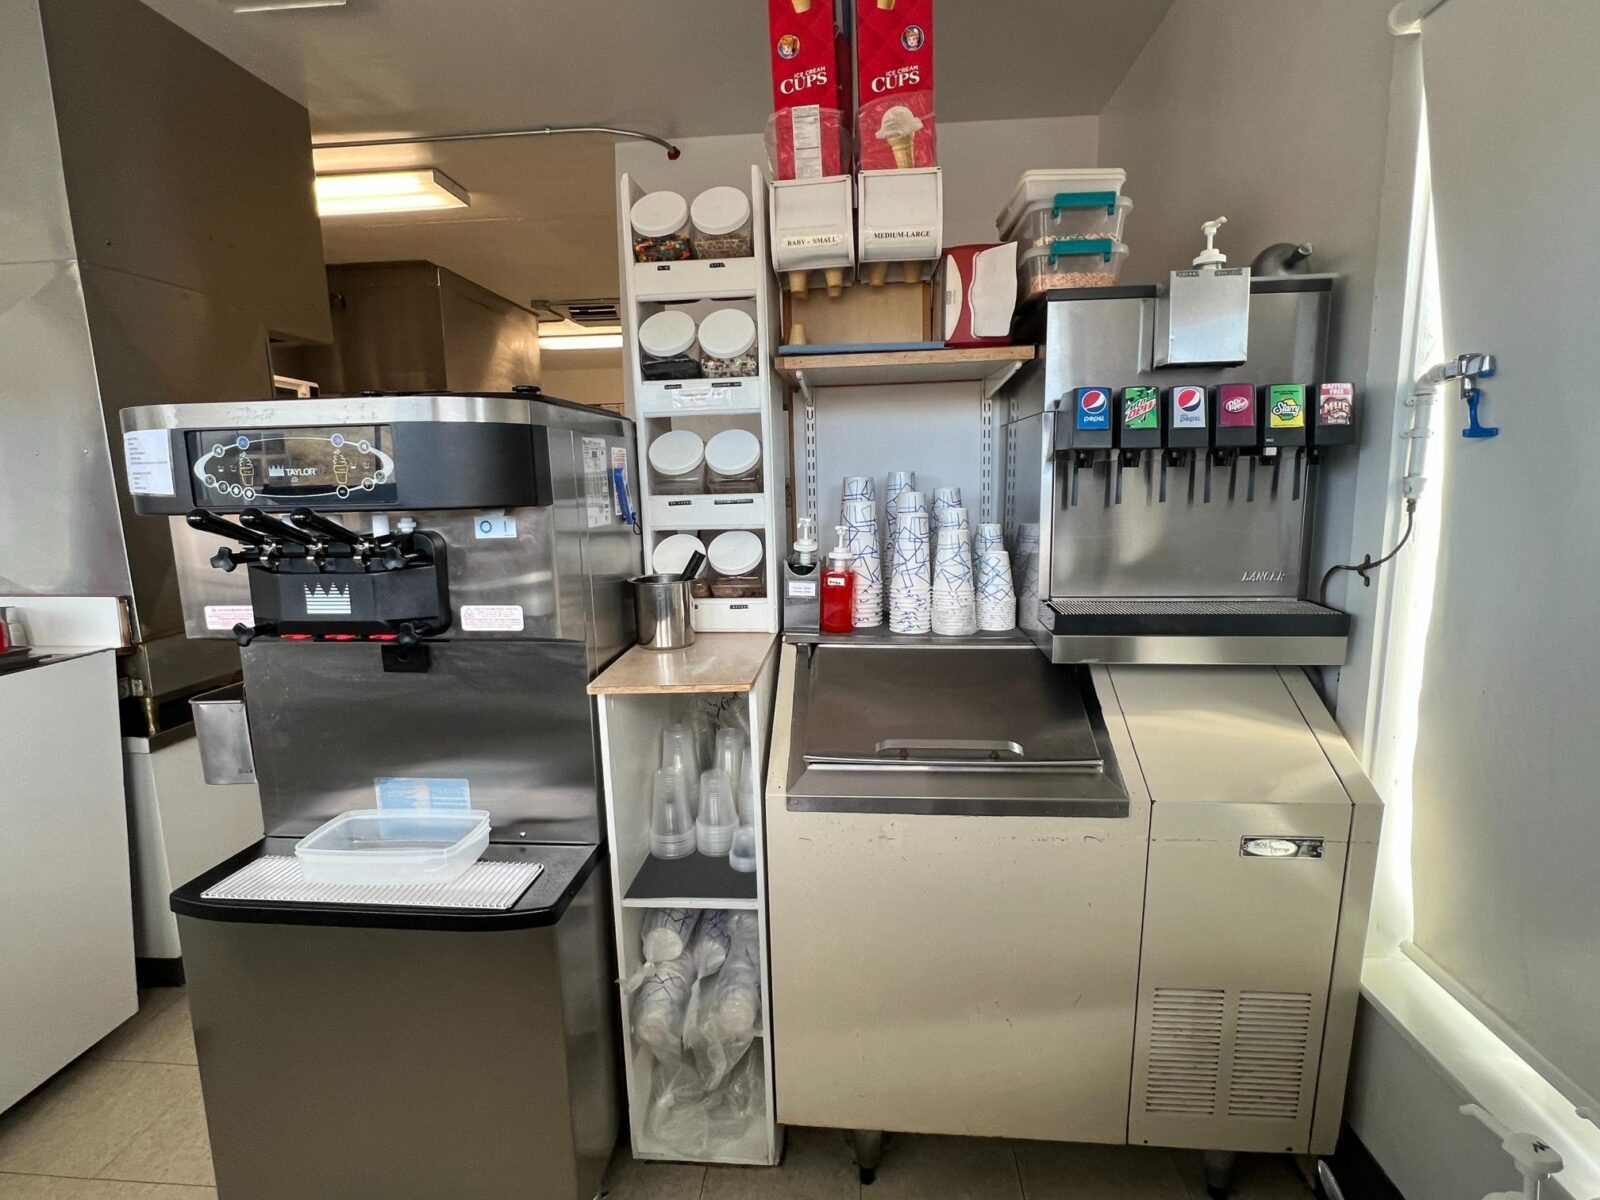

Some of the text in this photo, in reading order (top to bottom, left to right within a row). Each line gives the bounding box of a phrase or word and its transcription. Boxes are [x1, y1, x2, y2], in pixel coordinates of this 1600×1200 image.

[793, 66, 826, 79] ICE CREAM
[897, 65, 919, 75] CREAM
[780, 71, 828, 95] CUPS
[871, 70, 920, 93] CUPS
[812, 236, 837, 244] SMALL
[873, 230, 931, 239] MEDIUM-LARGE
[1272, 401, 1300, 417] Starry
[1323, 402, 1350, 414] MUG
[1083, 414, 1105, 423] pepsi
[285, 467, 317, 476] TAYLOR
